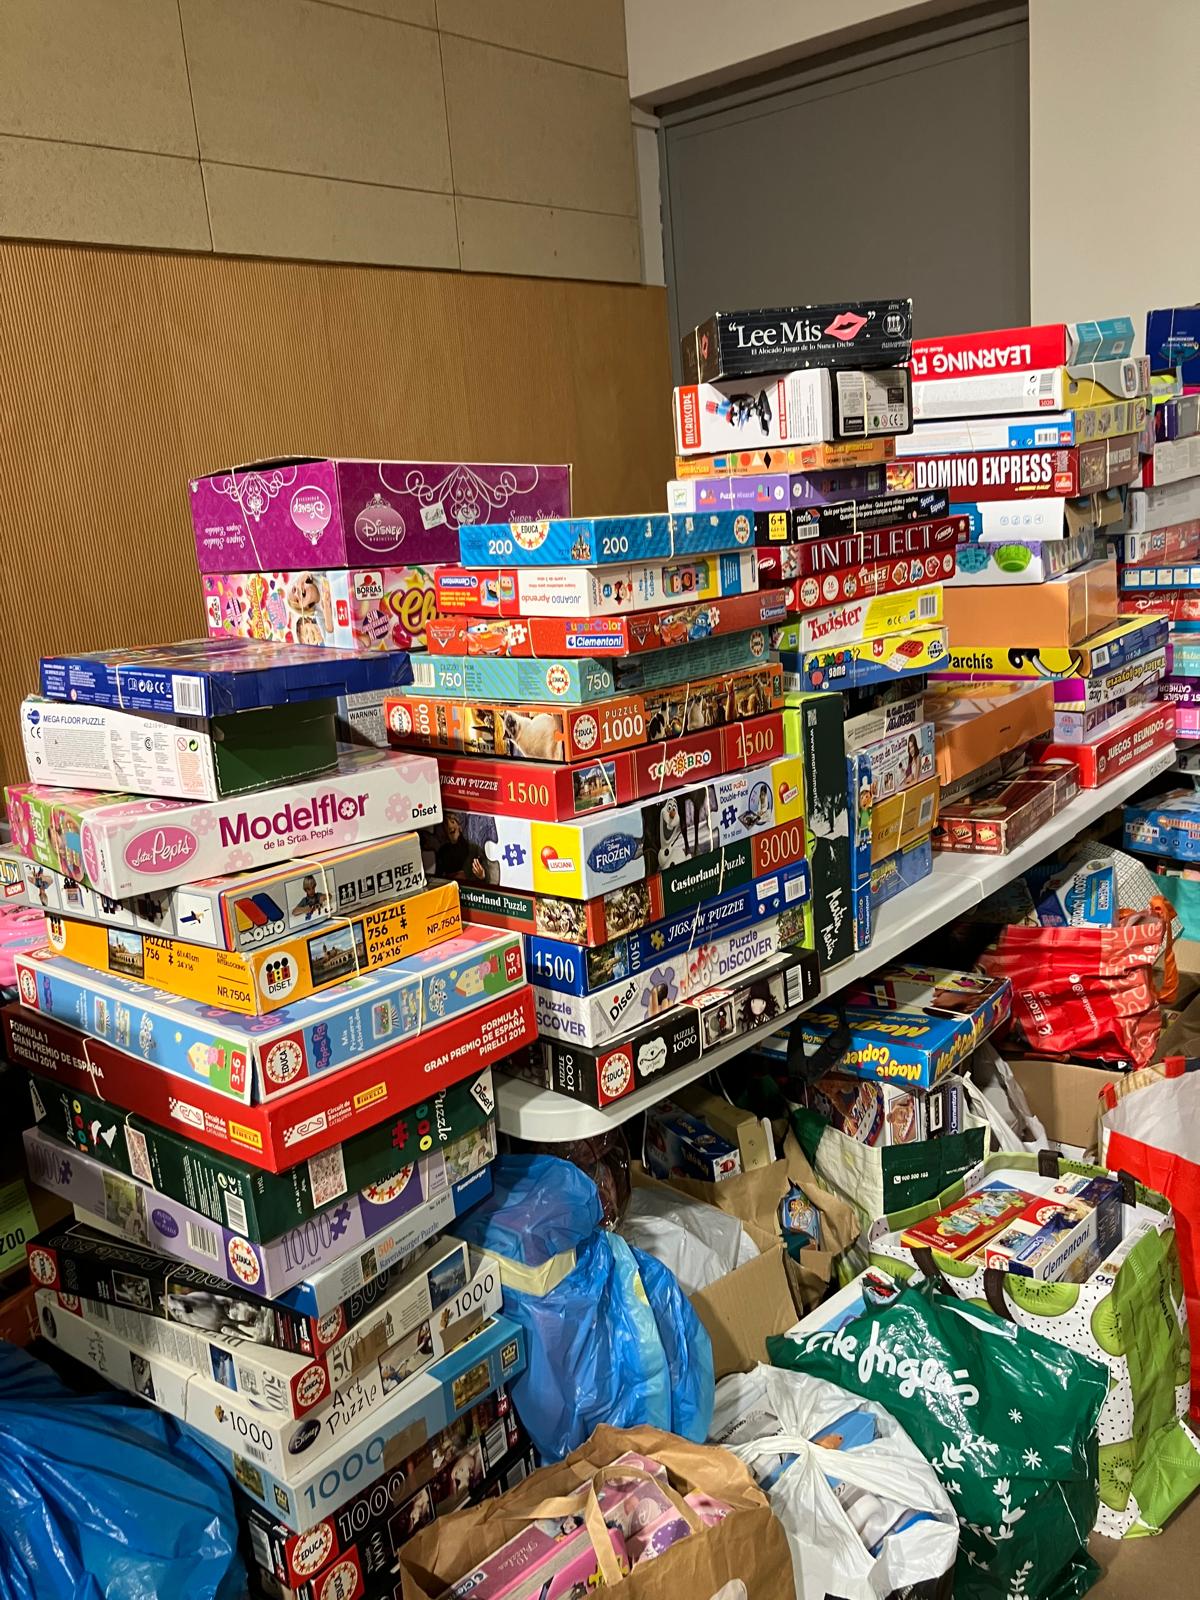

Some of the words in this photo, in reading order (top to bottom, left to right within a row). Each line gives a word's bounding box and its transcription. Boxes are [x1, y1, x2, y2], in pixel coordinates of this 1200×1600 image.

[780, 320, 822, 344] Mis
[758, 346, 782, 355] Alocado
[783, 345, 800, 355] Juego
[816, 342, 835, 350] Nunca
[836, 340, 854, 348] Dicho
[933, 344, 1031, 373] LEARNING
[683, 392, 695, 444] MICROSCOPE
[917, 455, 978, 488] DOMINO
[982, 453, 1052, 486] EXPRESS
[921, 495, 934, 507] Space
[930, 500, 945, 513] Espaço
[357, 517, 401, 541] Disney
[226, 533, 246, 549] Super
[488, 540, 512, 554] 200
[602, 536, 628, 554] 200
[811, 525, 933, 571] INTELECT
[357, 586, 381, 594] BORRAS
[441, 578, 470, 586] Clementoni
[522, 594, 550, 602] Aprendo
[551, 595, 581, 604] JUGANDO
[566, 620, 622, 633] SuperColor
[807, 606, 862, 641] Twister
[576, 636, 622, 647] Clementoni
[873, 644, 883, 653] 3+
[828, 664, 846, 679] game
[947, 653, 993, 670] Parchís
[439, 673, 461, 686] 750
[586, 673, 610, 691] 750
[43, 714, 60, 723] MEGA
[61, 716, 81, 725] FLOOR
[82, 716, 105, 726] PUZZLE
[350, 709, 378, 720] WARNING
[605, 704, 639, 719] PUZZLE
[578, 727, 592, 737] EDUCA
[602, 714, 644, 744] 1000
[1107, 737, 1130, 760] JUEGOS
[1133, 718, 1164, 746] REUNIDOS
[736, 729, 774, 759] 1500
[468, 779, 499, 791] PUZZLE
[507, 781, 549, 807] 1500
[720, 783, 732, 794] MAXI
[720, 789, 749, 804] Double-Face
[219, 793, 366, 848] Modelflor
[412, 803, 437, 819] Diset
[152, 830, 192, 865] Pepis
[264, 839, 276, 850] de
[278, 837, 285, 848] la
[287, 834, 307, 845] Srta.
[311, 827, 334, 840] Pepis
[760, 826, 799, 867] 3000
[551, 861, 572, 869] LISCIANI
[596, 846, 631, 868] FROZEN
[671, 863, 720, 892] Castorland
[503, 898, 528, 912] Puzzle
[708, 898, 744, 923] PUZZLE
[825, 887, 848, 934] Martin
[366, 904, 406, 927] PUZZLE
[241, 920, 285, 945] MOLTO
[368, 926, 388, 940] 756
[729, 931, 758, 951] Puzzle
[145, 936, 173, 951] PUZZLE
[630, 934, 640, 970] 1500
[146, 948, 160, 960] 756
[508, 952, 516, 976] 3-6
[719, 937, 772, 976] DISCOVER
[535, 951, 575, 984] 1500
[217, 986, 251, 1002] NR.7504
[268, 981, 291, 994] DISET
[539, 996, 572, 1016] Puzzle
[610, 981, 636, 1021] Diset
[10, 1020, 42, 1039] FORMULA
[481, 1009, 518, 1034] FORMULA
[479, 1037, 508, 1056] PIRELLI
[509, 1027, 526, 1042] 2014
[673, 1035, 697, 1053] 1000
[674, 1026, 695, 1042] PUZZLE
[424, 1055, 449, 1073] GRAN
[450, 1041, 481, 1064] PREMIO
[483, 1033, 495, 1045] DE
[496, 1016, 525, 1040] ESPAÑA
[12, 1032, 30, 1049] GRAN
[32, 1039, 60, 1059] PREMIO
[61, 1054, 72, 1063] DE
[73, 1057, 104, 1079] ESPAÑA
[13, 1043, 39, 1063] PIRELLI
[40, 1057, 57, 1070] 2014
[281, 1050, 289, 1074] EDUCA
[842, 1046, 890, 1066] Copier
[232, 1058, 240, 1084] 3-6
[607, 1068, 624, 1082] EDUCA
[877, 1063, 922, 1081] Magic
[357, 1085, 385, 1105] PIRELLI
[475, 1084, 493, 1110] Diset
[327, 1104, 342, 1115] Circuit
[327, 1107, 351, 1121] Barcelona
[435, 1088, 452, 1142] Puzzle
[950, 1087, 958, 1135] Clementoni
[421, 1221, 440, 1240] Puzzle
[281, 1214, 332, 1272] 1000
[378, 1237, 394, 1257] 500
[1042, 1223, 1090, 1281] Clementoni
[454, 1274, 494, 1318] 1000
[322, 1314, 337, 1331] EDUCA
[262, 1371, 285, 1412] 500
[304, 1378, 320, 1393] EDUCA
[332, 1378, 363, 1410] Art
[325, 1385, 377, 1435] Puzzle
[230, 1411, 273, 1451] 1000
[304, 1436, 386, 1509] 1000
[339, 1471, 405, 1542] 1000
[300, 1536, 324, 1562] EDUCA
